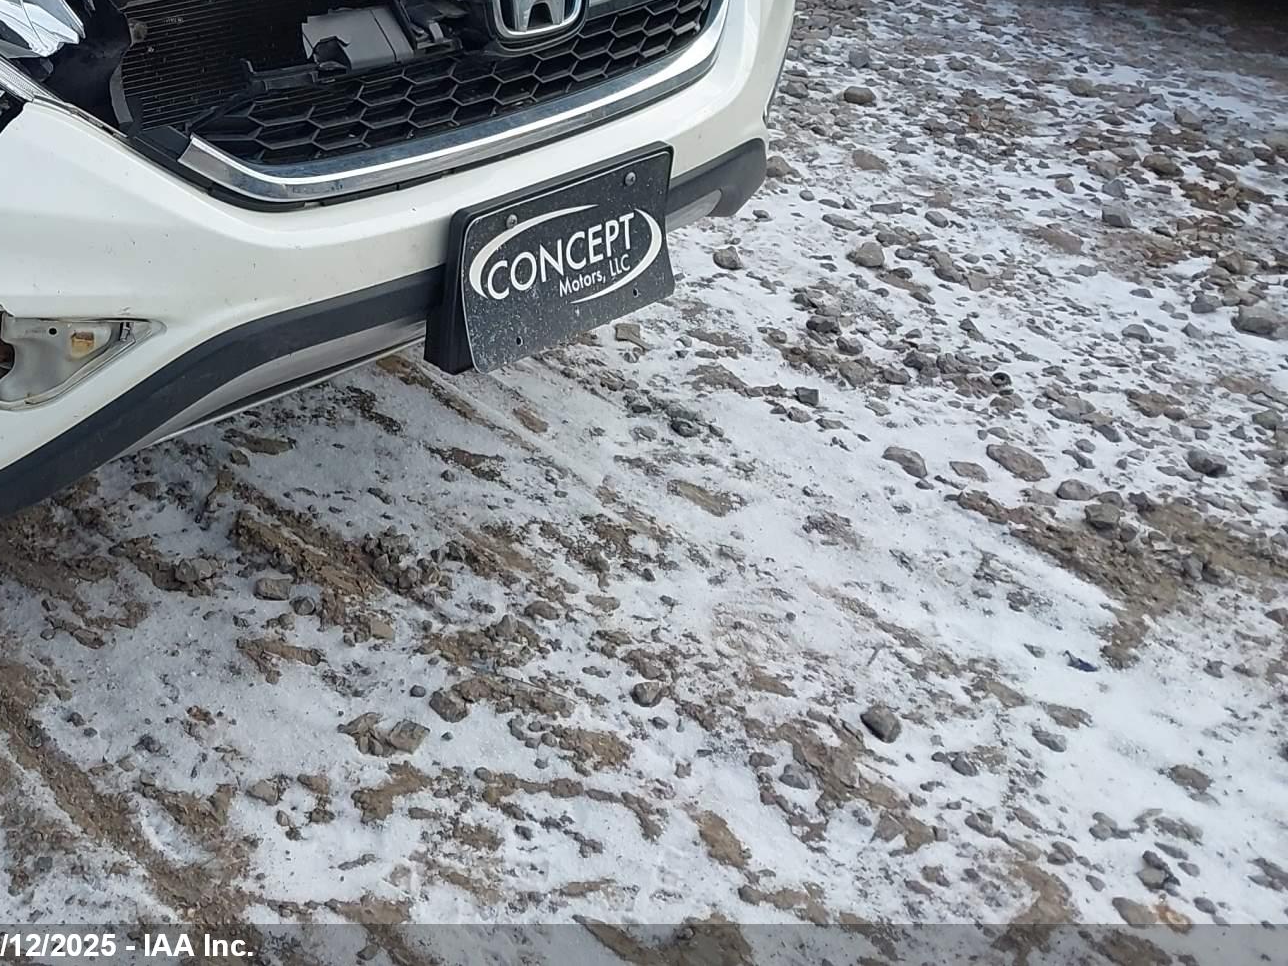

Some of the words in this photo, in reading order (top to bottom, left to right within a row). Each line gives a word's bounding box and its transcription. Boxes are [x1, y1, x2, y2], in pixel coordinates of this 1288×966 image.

[487, 212, 635, 300] CONCEPT
[559, 270, 606, 298] Motors,
[609, 253, 631, 277] LLC
